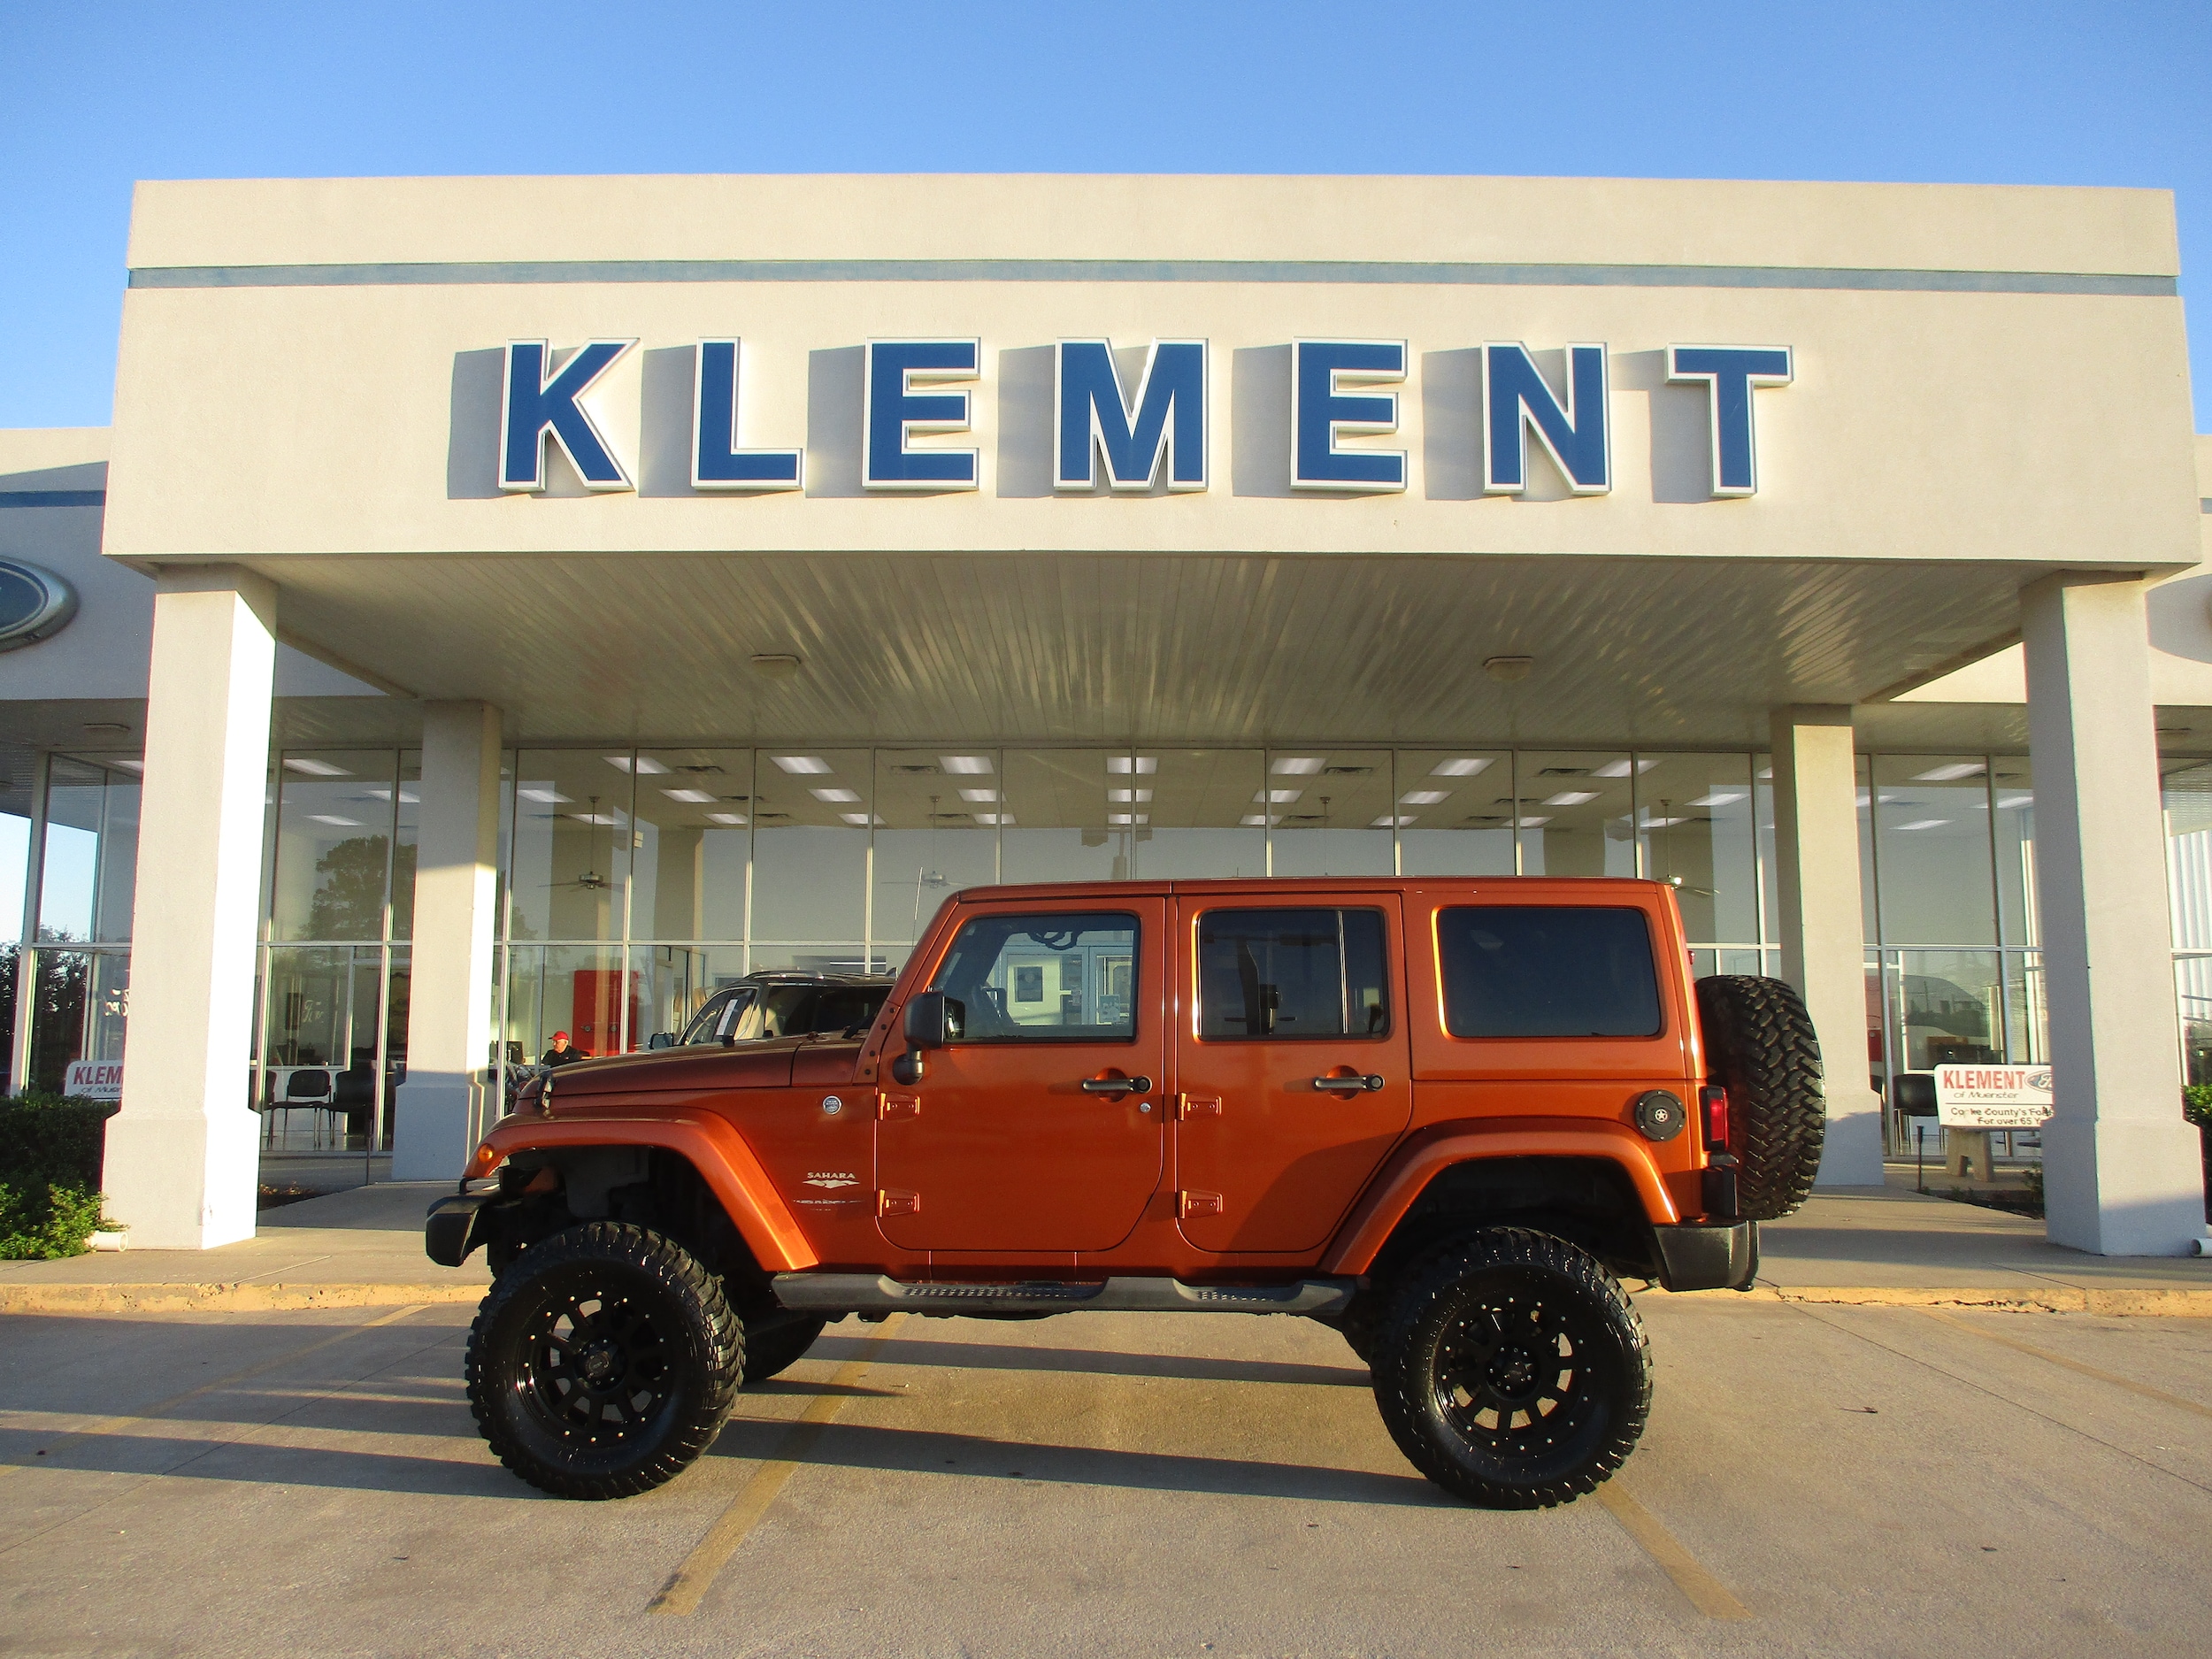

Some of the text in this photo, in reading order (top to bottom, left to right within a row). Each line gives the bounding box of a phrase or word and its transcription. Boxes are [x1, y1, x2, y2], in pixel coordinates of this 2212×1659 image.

[497, 335, 1793, 497] KLEMENT
[1943, 1070, 2025, 1089] KLEMENT
[1985, 1108, 2027, 1118] County's
